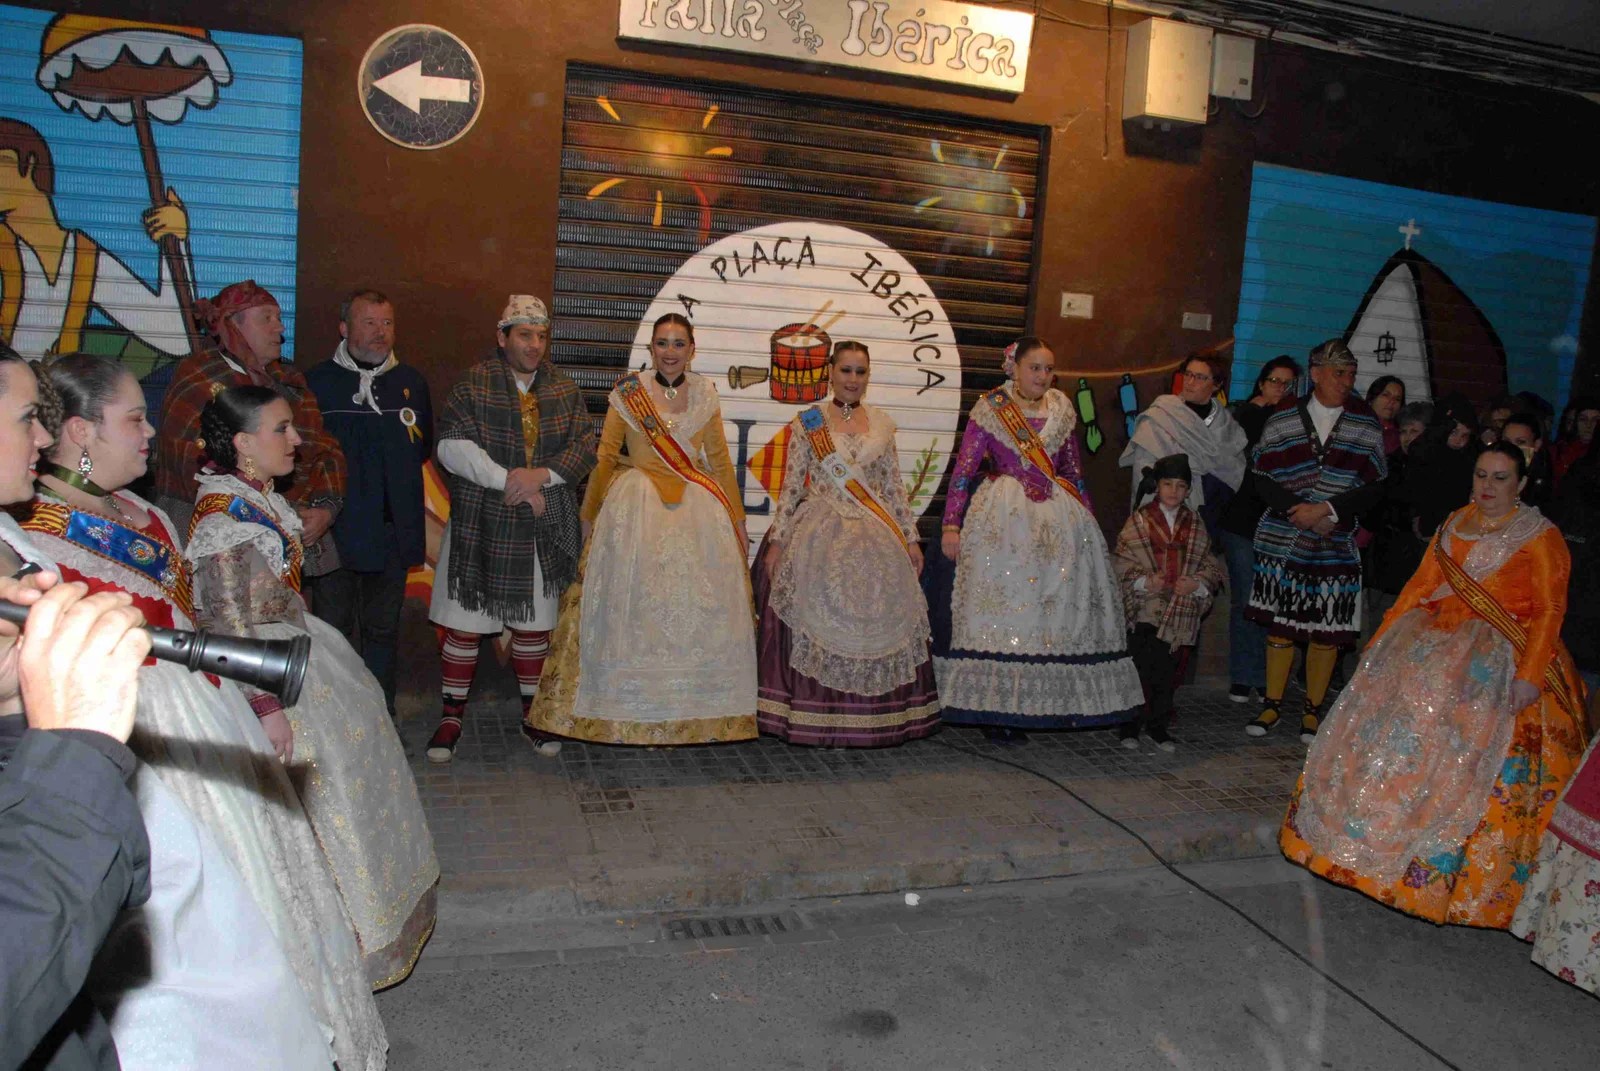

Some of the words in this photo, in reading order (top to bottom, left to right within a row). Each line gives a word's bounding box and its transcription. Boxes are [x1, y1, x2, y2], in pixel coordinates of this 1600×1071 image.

[840, 1, 1017, 77] Ibérica
[710, 235, 816, 284] PLAÇA
[850, 252, 946, 396] IBÉRICA
